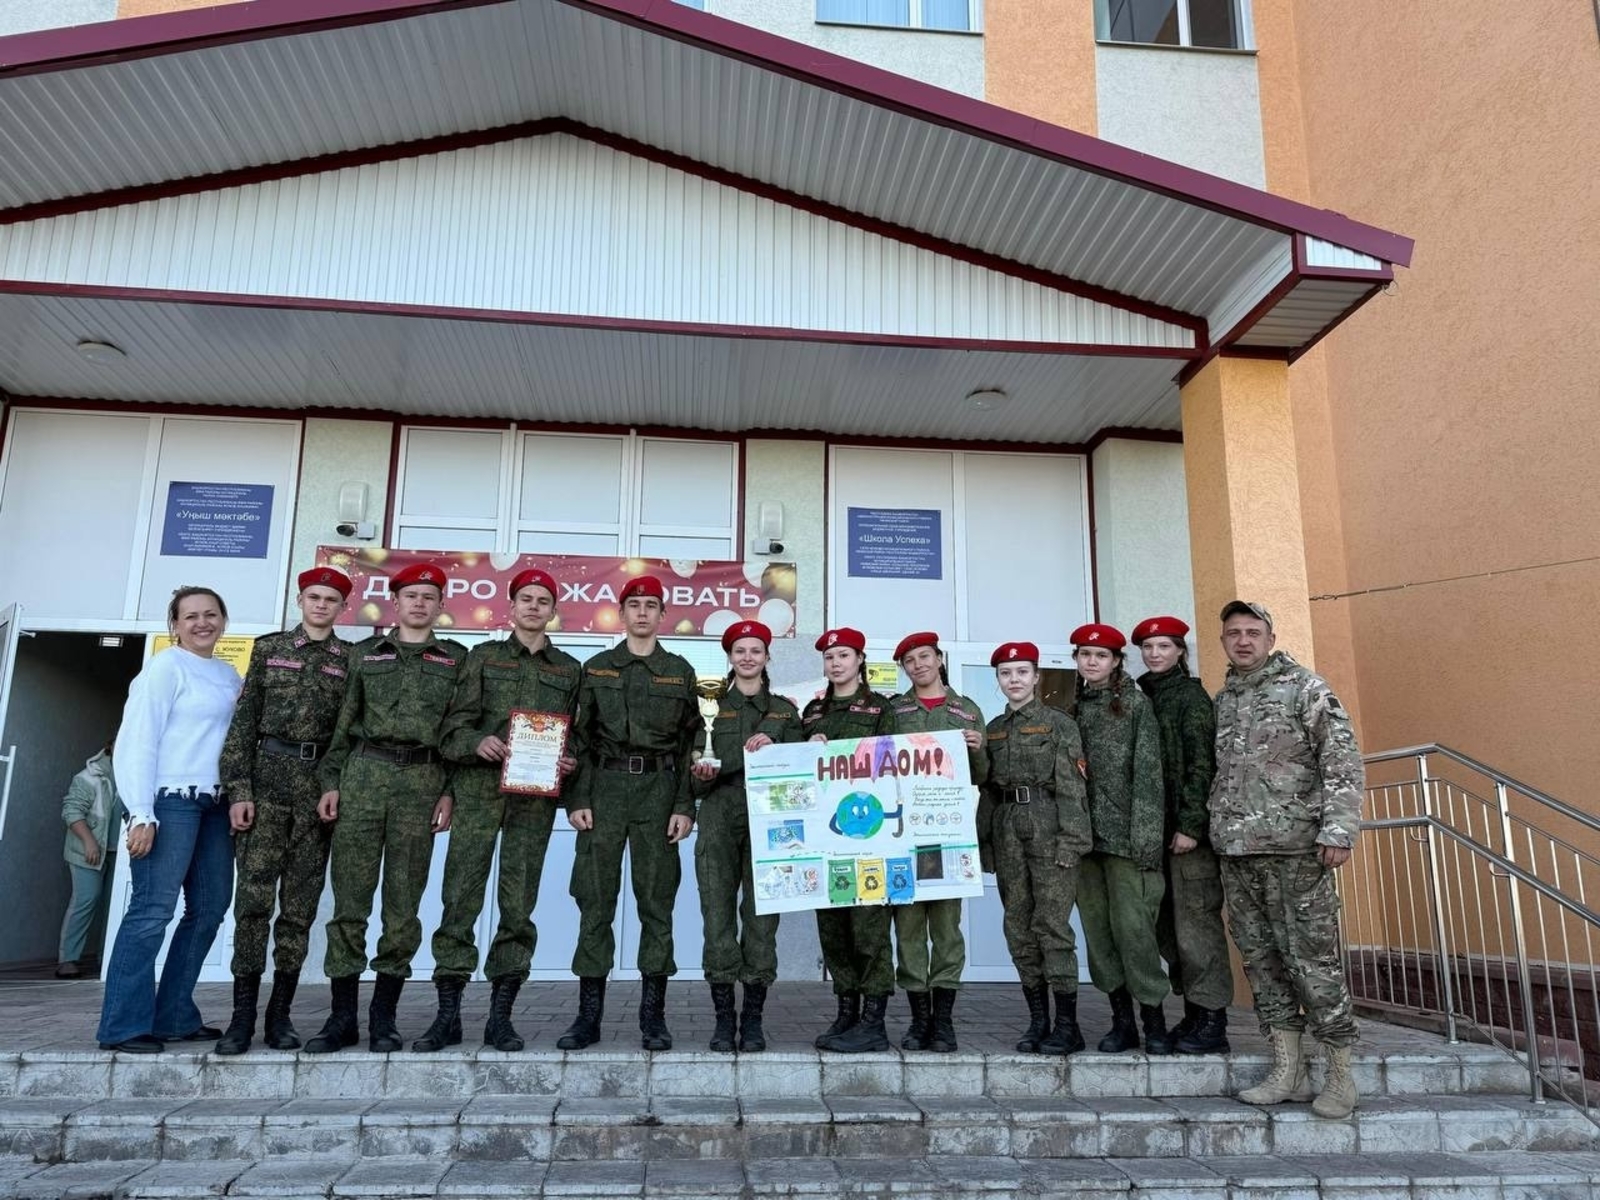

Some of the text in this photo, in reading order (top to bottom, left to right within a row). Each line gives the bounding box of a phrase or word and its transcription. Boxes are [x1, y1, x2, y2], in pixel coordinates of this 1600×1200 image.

[859, 534, 931, 545] «Школа Успеха»
[362, 576, 761, 607] ДРО ЖАВАТЬ
[516, 732, 557, 743] ДИПЛОМ
[818, 747, 944, 780] НАШ ДОМ!
